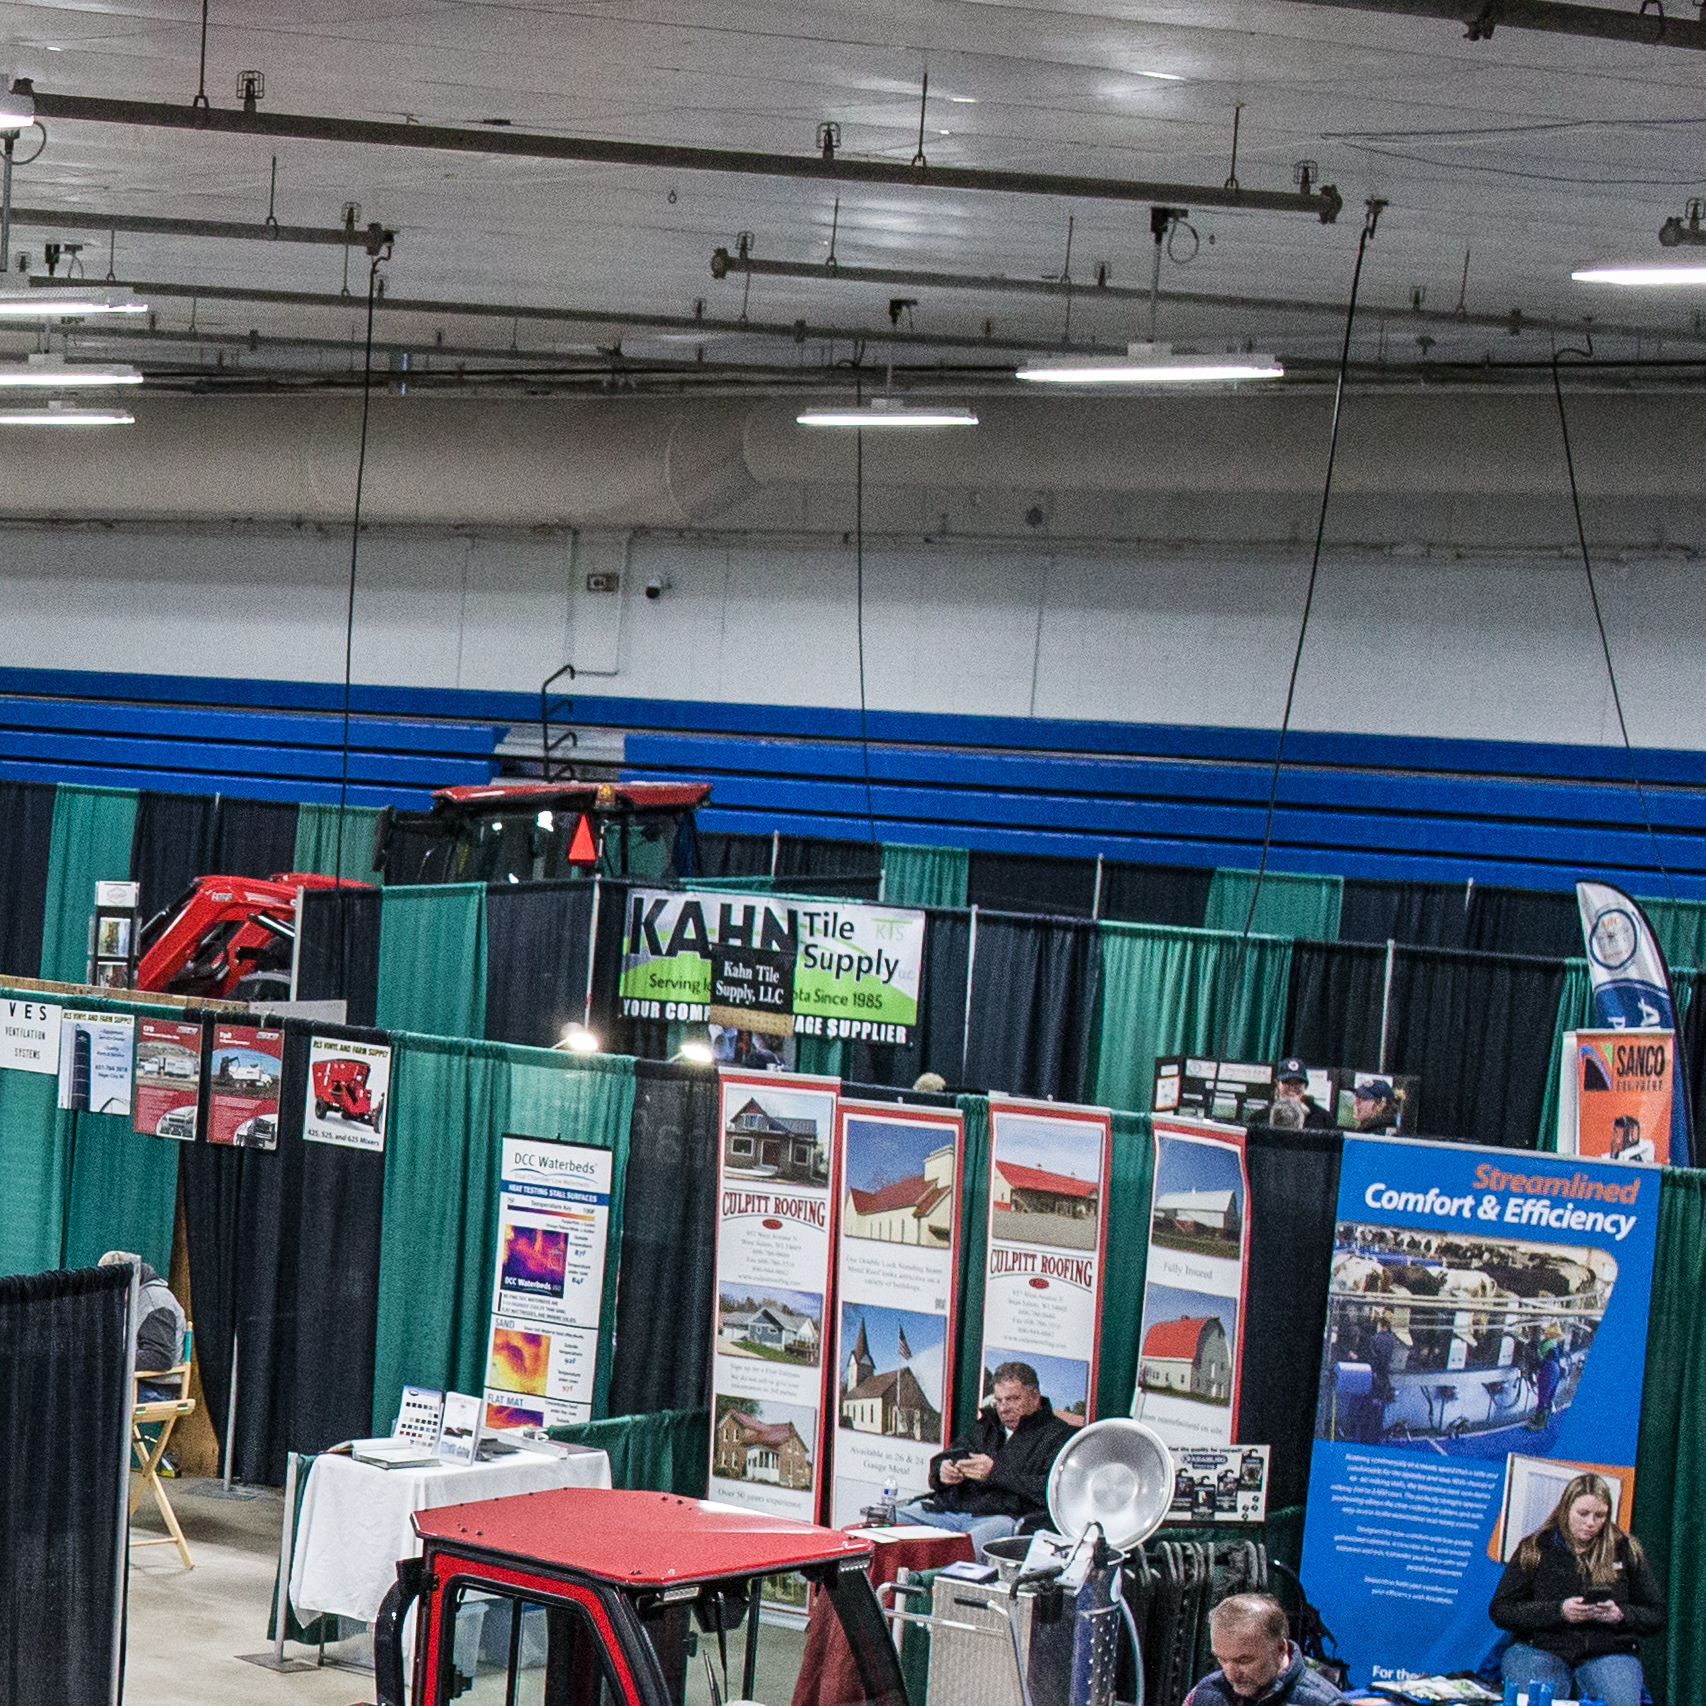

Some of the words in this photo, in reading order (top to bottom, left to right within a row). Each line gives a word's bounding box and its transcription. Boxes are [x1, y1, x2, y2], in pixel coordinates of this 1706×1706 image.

[630, 897, 798, 960] KAHN
[803, 911, 856, 940] Tile
[724, 961, 752, 981] Kahn
[756, 965, 780, 984] Tile
[802, 943, 900, 985] Supply
[649, 974, 700, 994] Serving
[716, 981, 755, 1003] Supply,
[759, 986, 784, 1005] LLC
[815, 988, 848, 1007] Since
[852, 993, 882, 1010] 1985
[5, 1026, 46, 1040] VENTILATION
[623, 999, 660, 1018] YOUR
[827, 1019, 907, 1044] SUPPLIER
[1617, 1044, 1666, 1077] SANCO
[514, 1152, 535, 1166] DCC
[538, 1156, 595, 1174] Waterbeds
[1472, 1163, 1640, 1205] Streamlined
[722, 1190, 770, 1217] CULPITT
[774, 1196, 827, 1228] ROOFING
[1364, 1182, 1475, 1218] Comfort
[1477, 1195, 1499, 1222] &
[1504, 1197, 1638, 1241] Efficiency
[990, 1249, 1038, 1275] CULPITT
[1041, 1255, 1094, 1288] ROOFING
[1163, 1261, 1183, 1277] Fully
[1185, 1264, 1213, 1281] Insured
[1372, 1663, 1395, 1681] For
